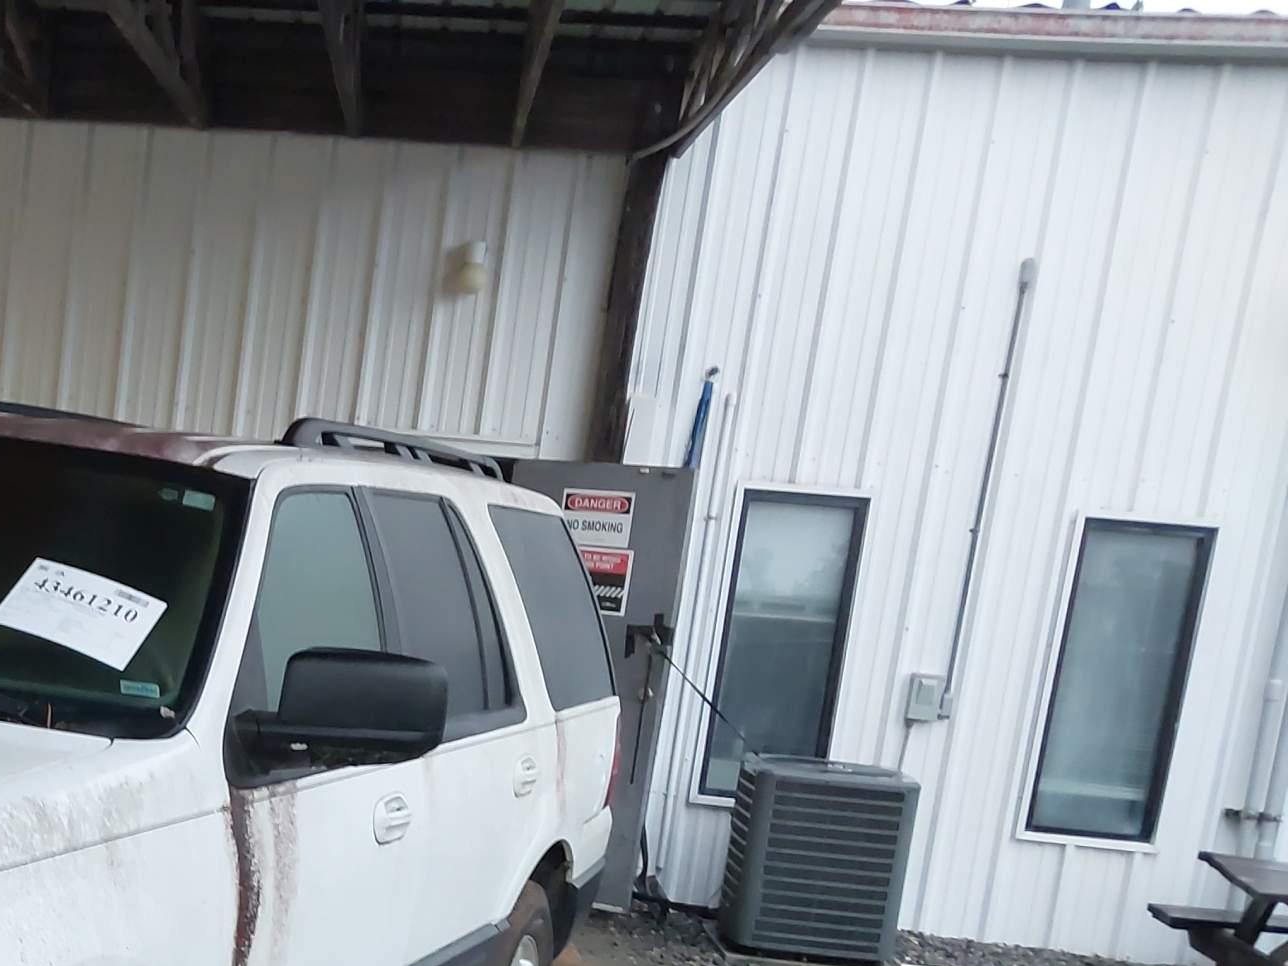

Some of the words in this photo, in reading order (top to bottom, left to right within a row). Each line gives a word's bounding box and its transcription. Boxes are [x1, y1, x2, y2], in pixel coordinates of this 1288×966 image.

[575, 497, 622, 510] DANGER
[567, 519, 579, 531] NO
[581, 520, 623, 533] SMOKING
[34, 577, 139, 624] 43461210
